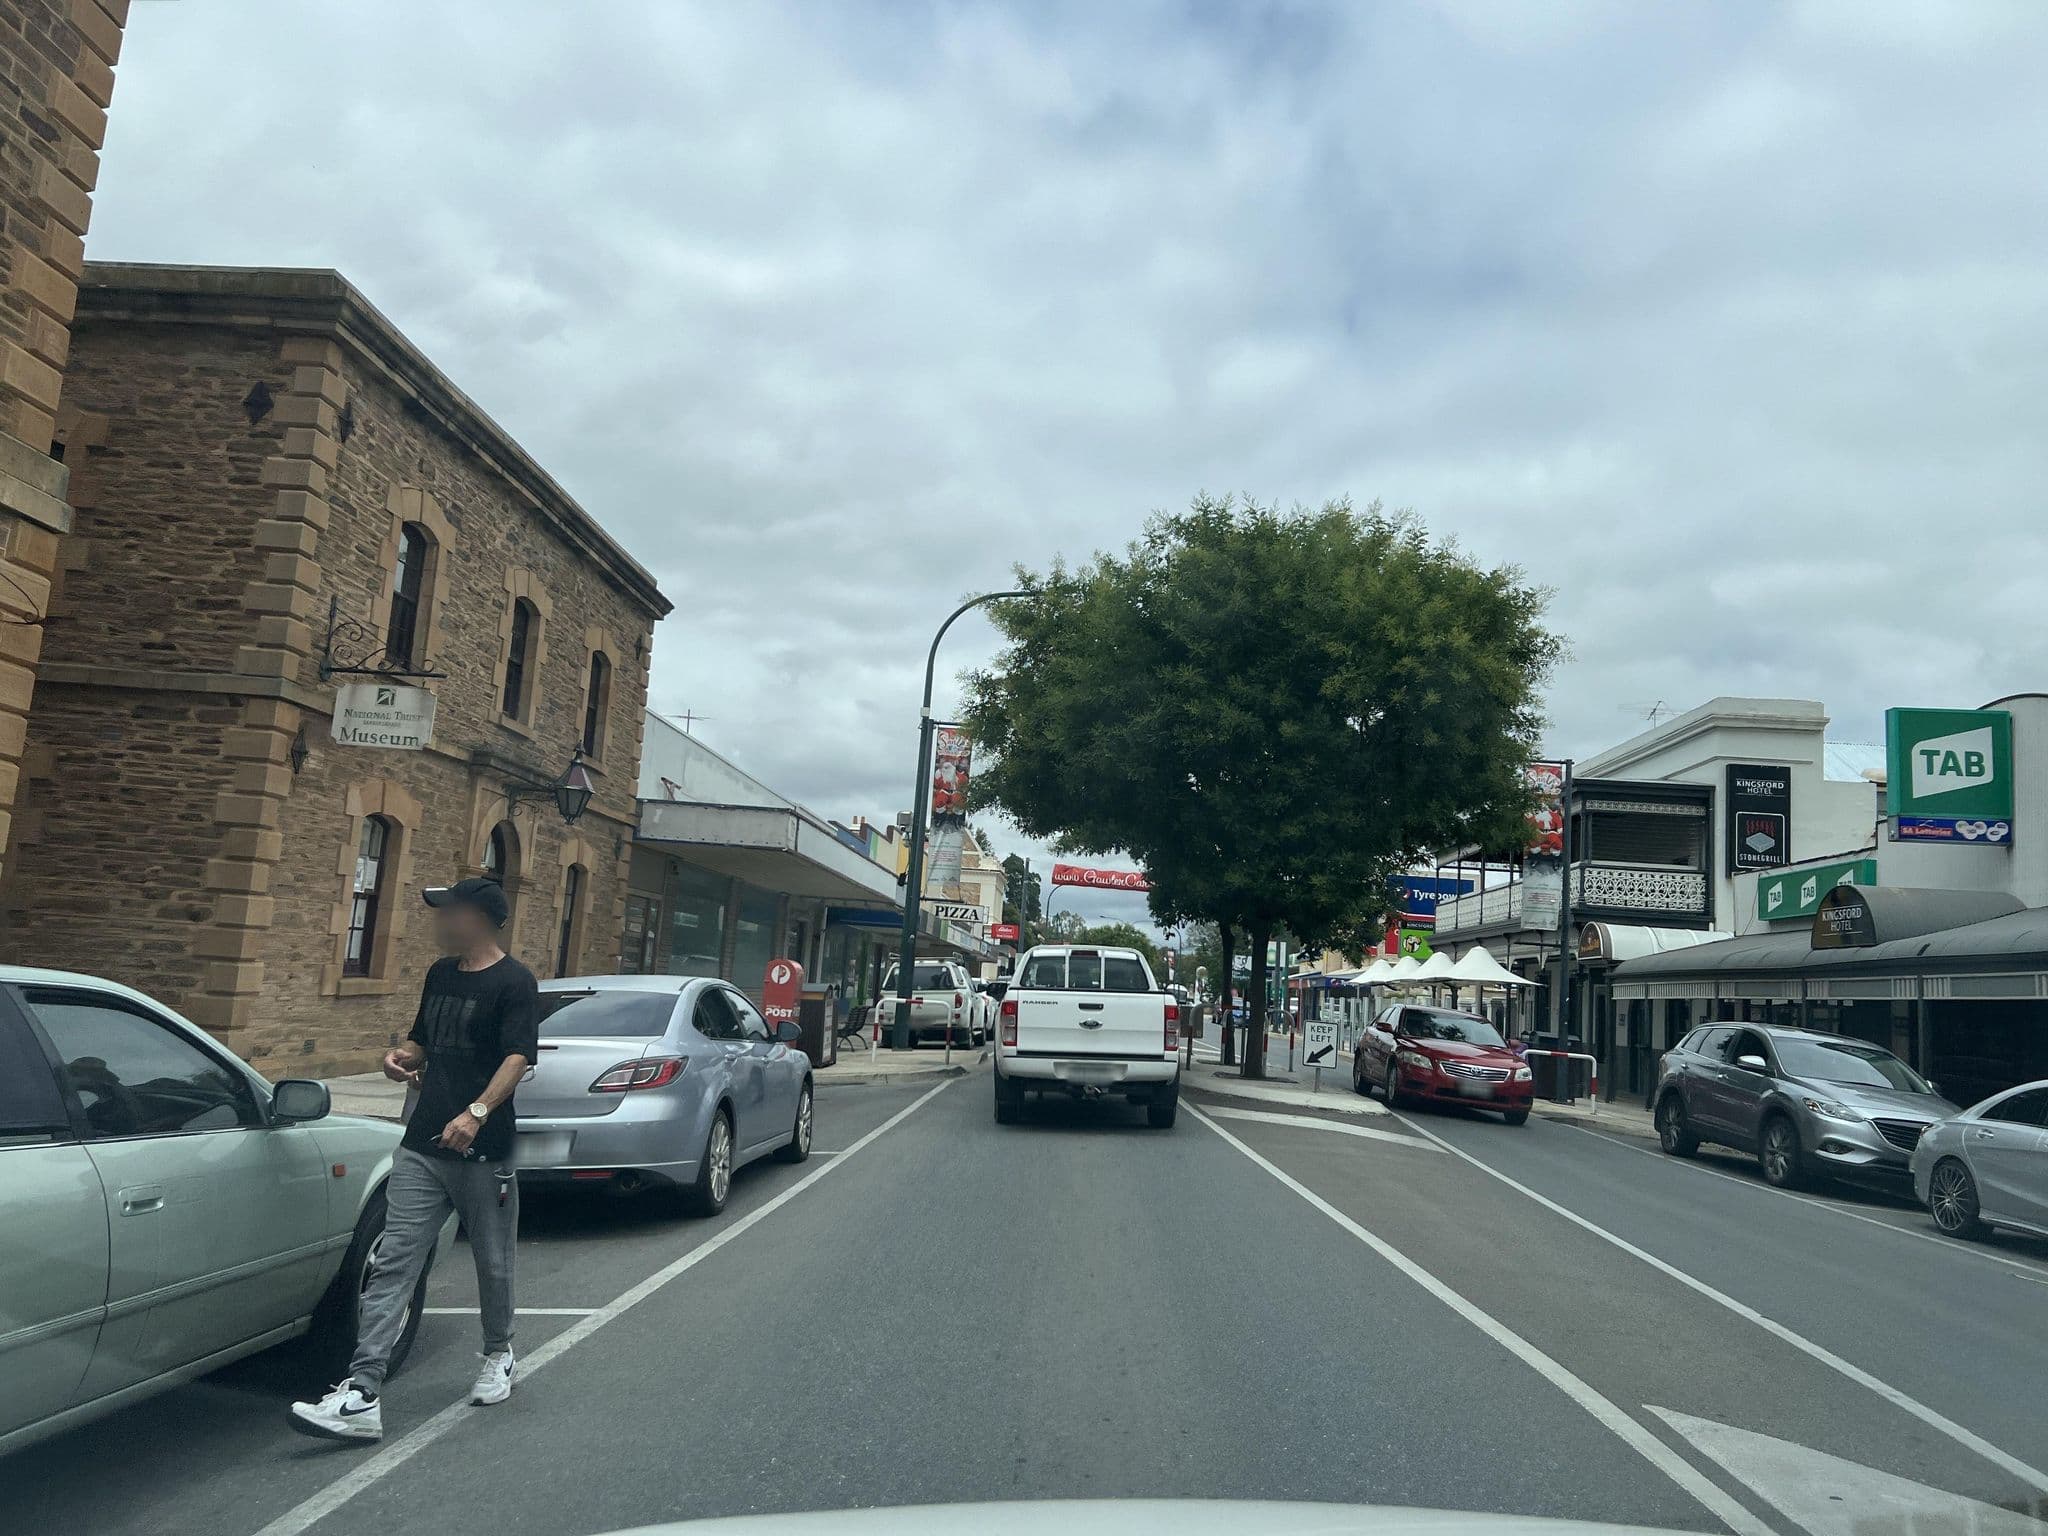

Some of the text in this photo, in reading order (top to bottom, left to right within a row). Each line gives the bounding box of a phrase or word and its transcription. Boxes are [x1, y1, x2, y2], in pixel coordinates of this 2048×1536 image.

[344, 708, 391, 719] NATIONAL
[340, 727, 419, 746] Museum
[1919, 749, 1986, 777] TAB
[1736, 780, 1785, 790] KINGSFORD
[1054, 870, 1155, 888] www.GawlerCar
[1769, 890, 1781, 903] TAB
[1803, 887, 1816, 898] TAB
[935, 905, 979, 921] PIZZA
[1822, 908, 1862, 922] KINGSFORD
[1830, 920, 1852, 932] HOTEL
[765, 1007, 793, 1017] POST
[1310, 1024, 1333, 1034] KEEP
[1310, 1034, 1332, 1043] LEFT
